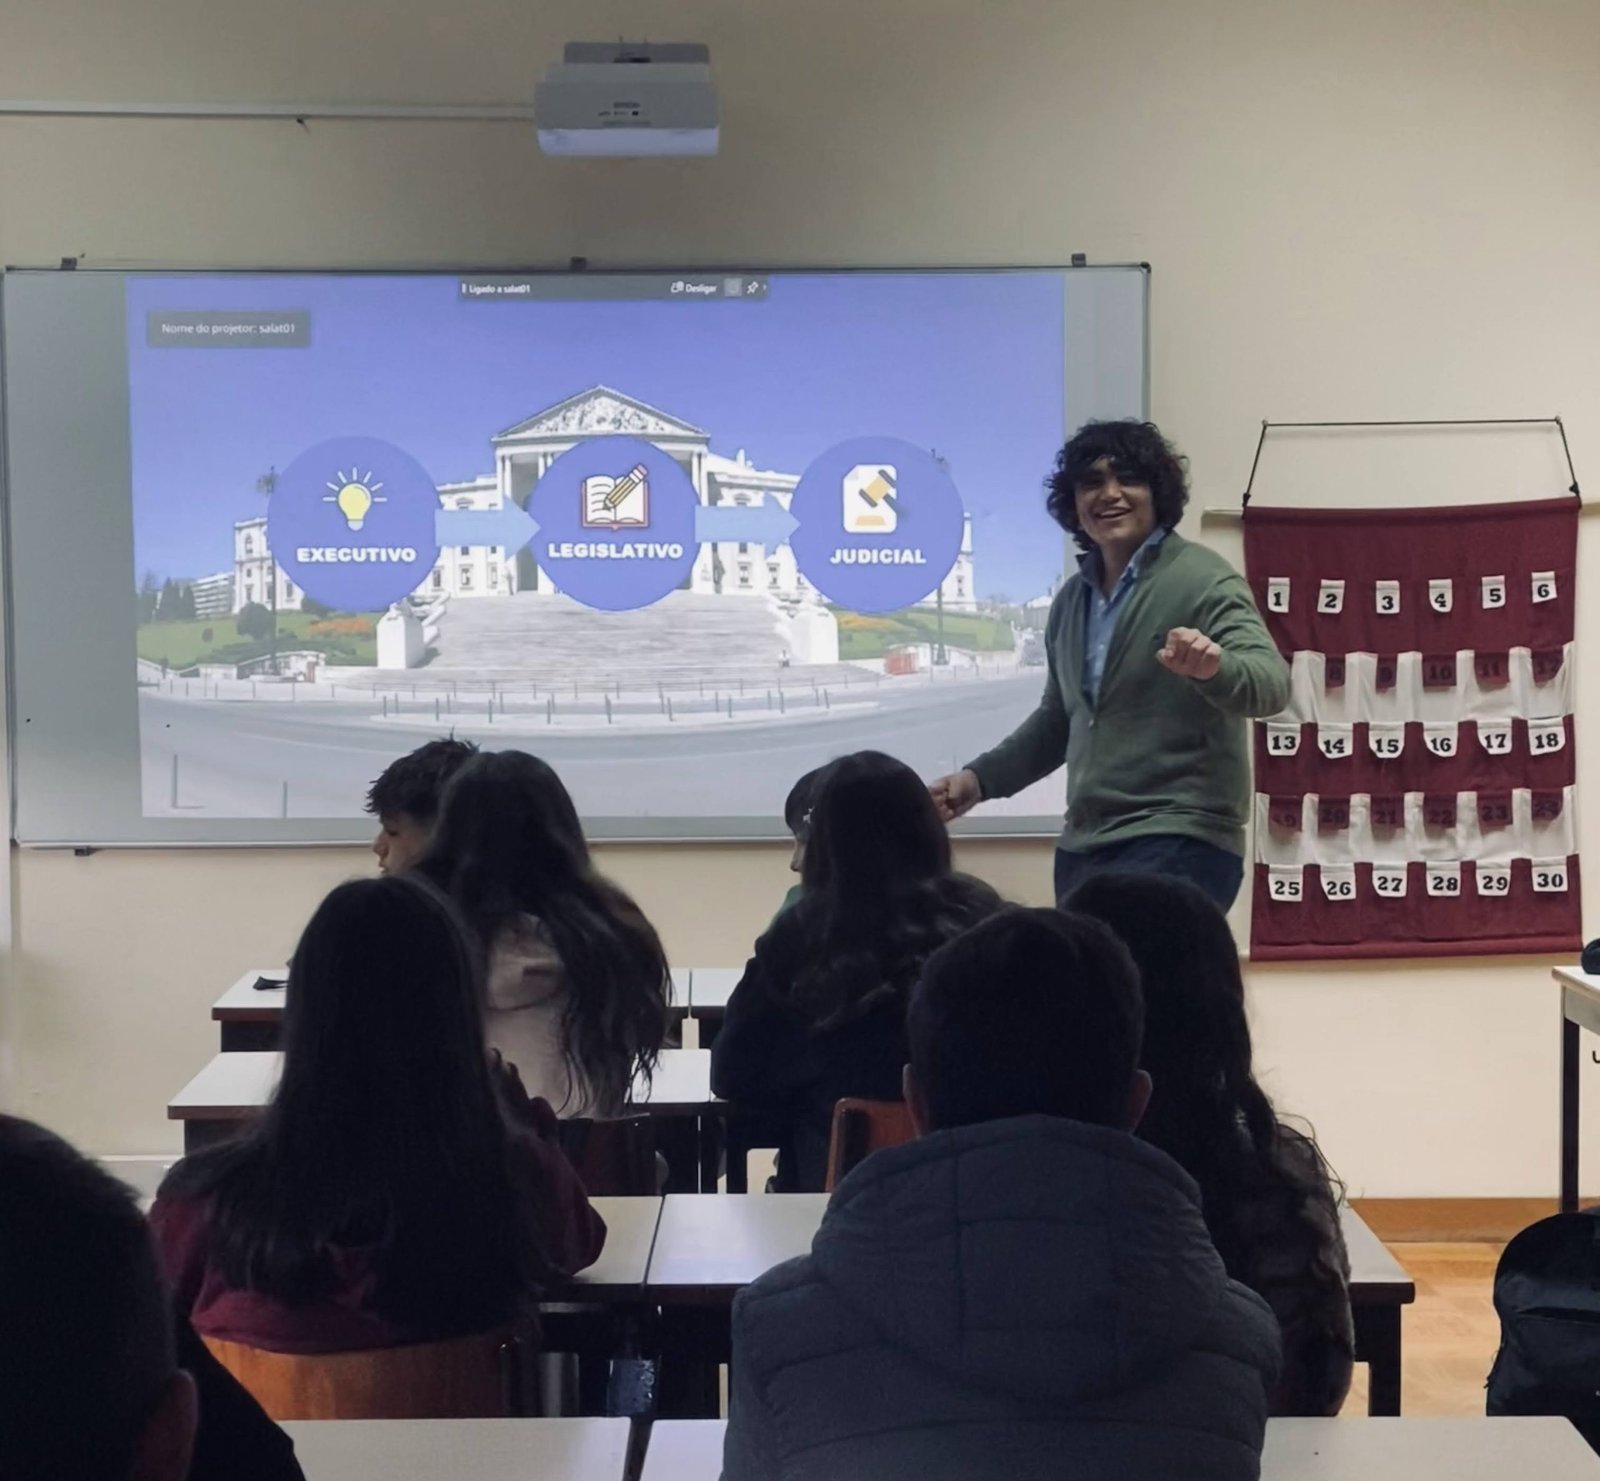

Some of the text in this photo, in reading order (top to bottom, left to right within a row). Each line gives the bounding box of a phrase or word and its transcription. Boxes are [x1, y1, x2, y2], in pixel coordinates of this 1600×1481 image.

[469, 284, 496, 295] Ligado
[685, 283, 717, 295] Desligar
[161, 323, 295, 336] Nome do projetor: salat01
[296, 547, 416, 563] EXECUTIVO
[548, 543, 683, 559] LEGISLATIVO
[829, 548, 927, 564] JUDICIAL
[1273, 584, 1550, 610] 1 2 3 4 5 6
[1429, 664, 1452, 680] 10
[1272, 733, 1559, 754] 13 14 15 16 17 18
[1274, 873, 1564, 896] 25 26 27 28 29 30
